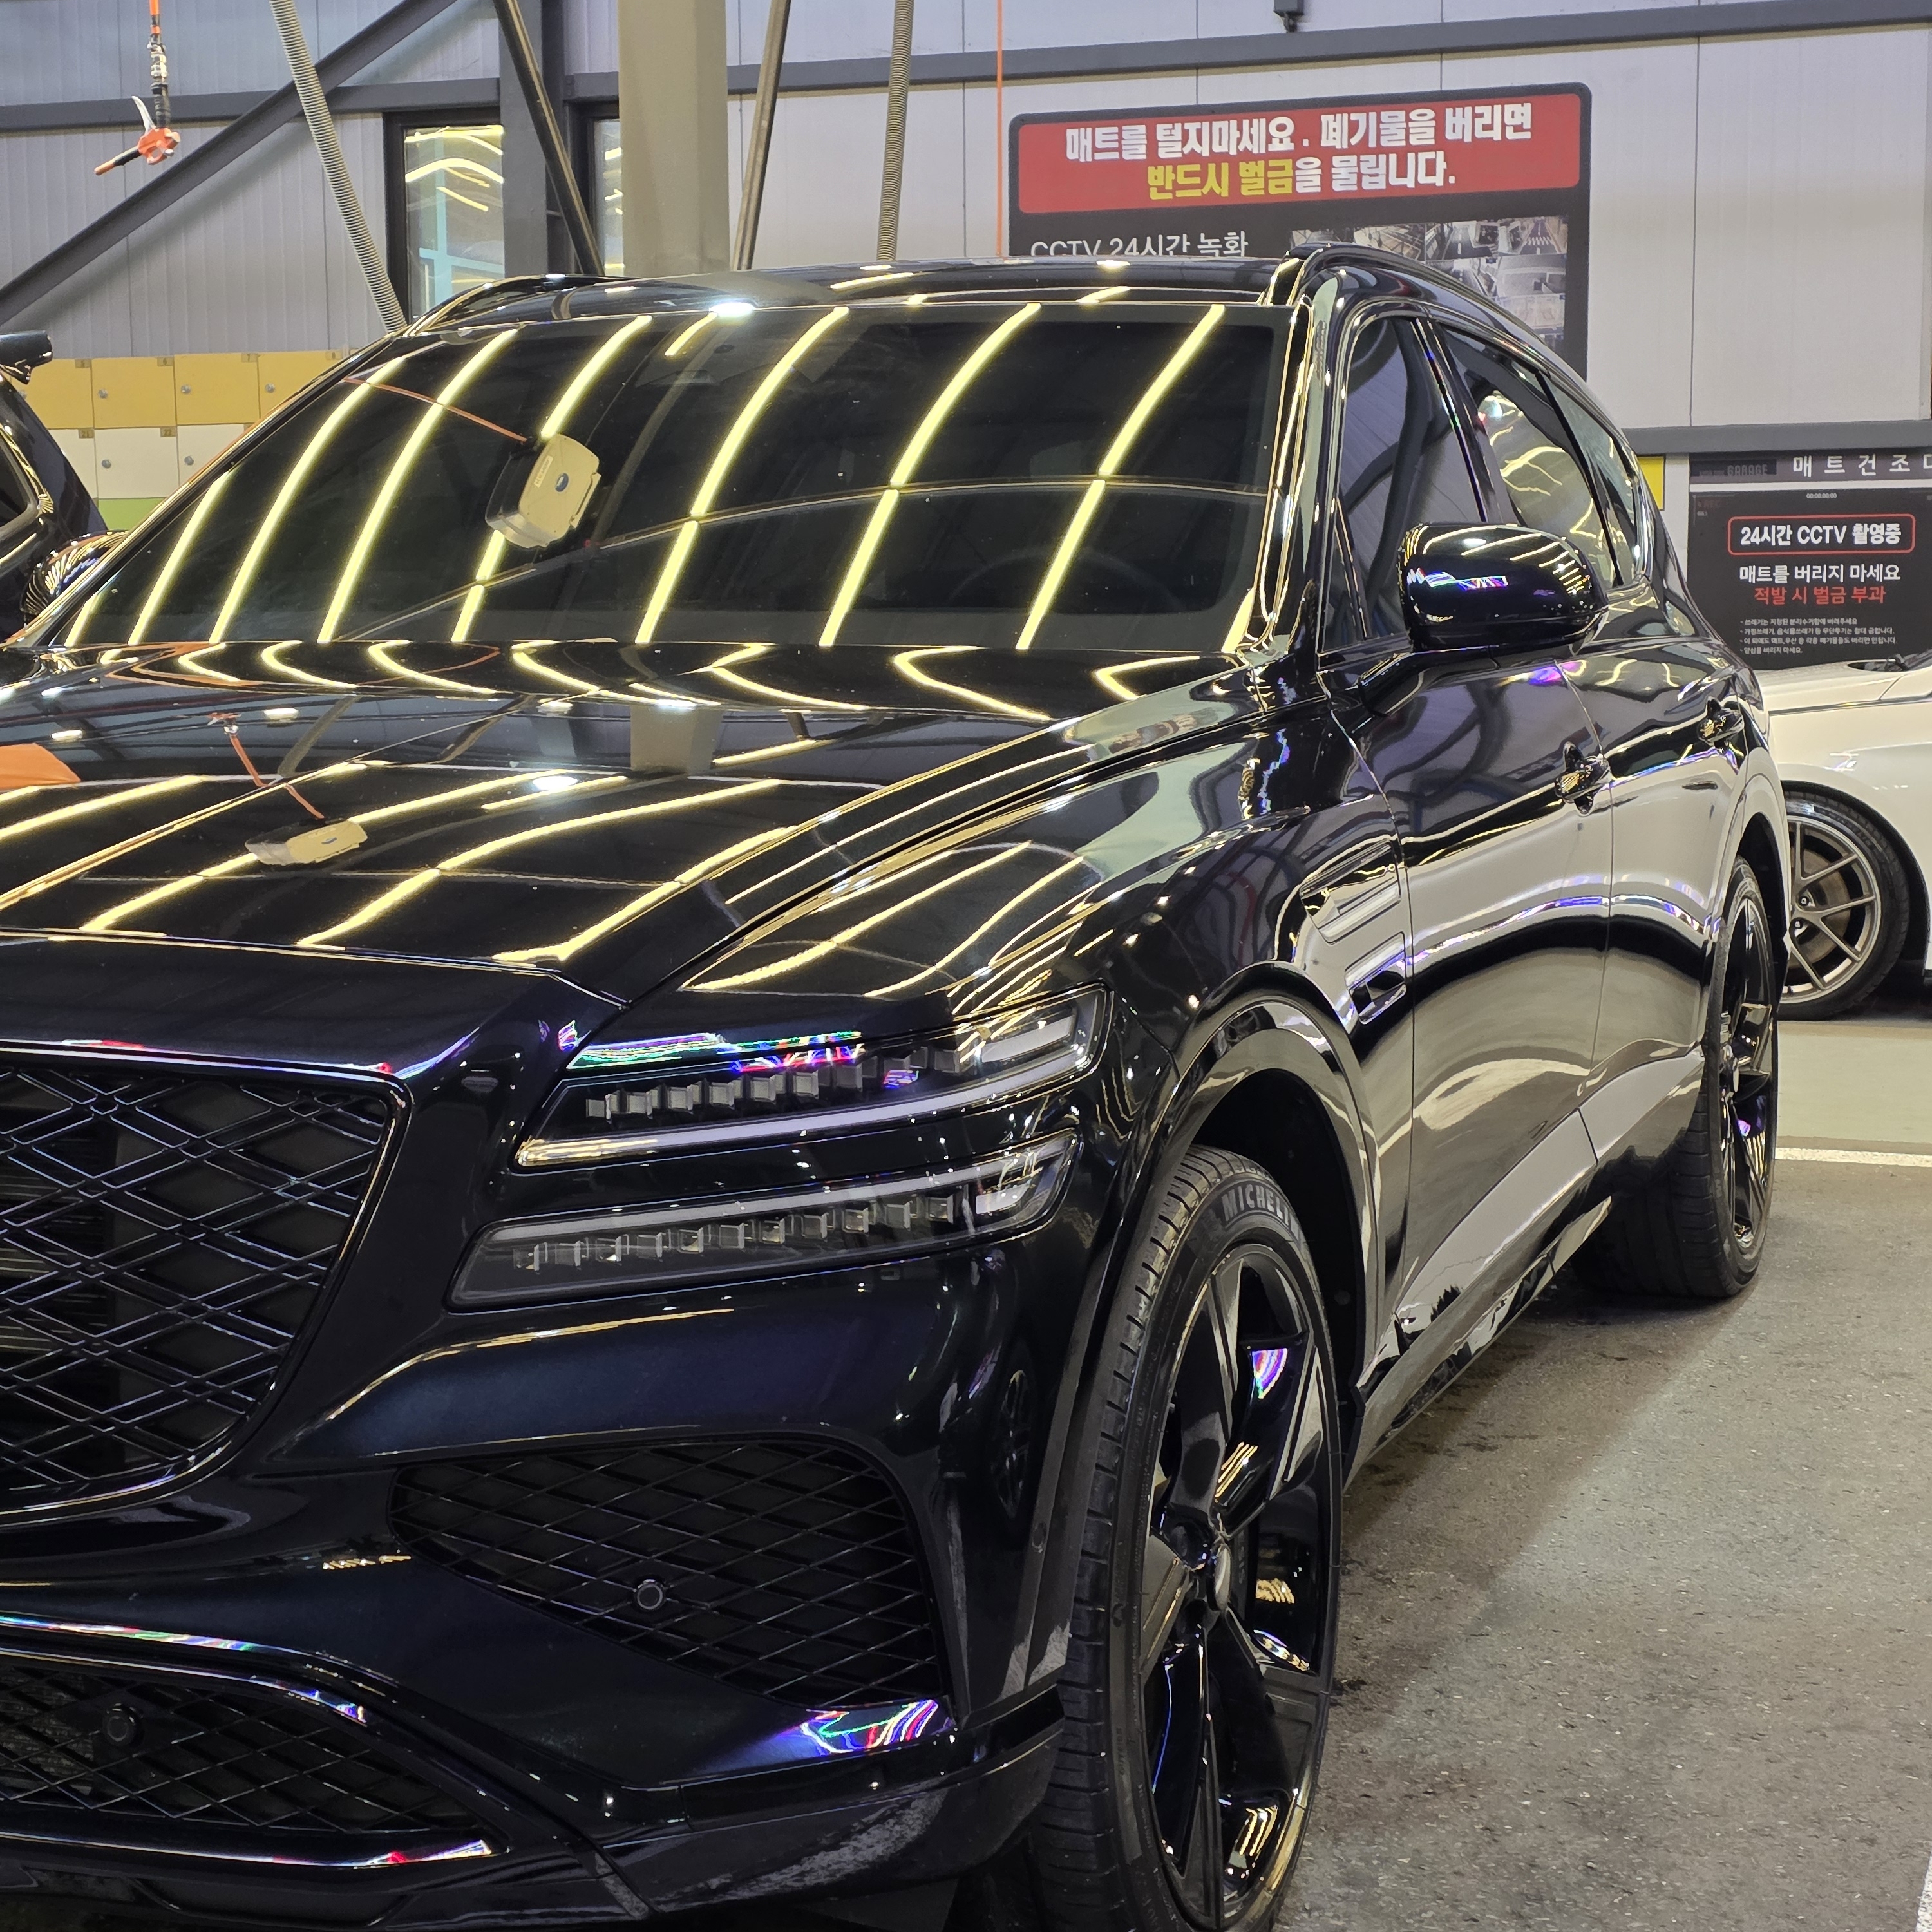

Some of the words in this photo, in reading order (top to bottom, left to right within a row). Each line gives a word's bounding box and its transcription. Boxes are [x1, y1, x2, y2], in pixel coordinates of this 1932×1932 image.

[1066, 124, 1147, 162] 매트를
[1320, 108, 1437, 149] 폐기물을
[1445, 102, 1531, 143] 버리면
[1148, 162, 1229, 200] 반드시
[1239, 156, 1321, 196] 벌금을
[1331, 151, 1455, 192] 물립니다.
[1030, 239, 1101, 256] CCTV
[1197, 231, 1248, 258] 녹화
[1741, 524, 1793, 546] 24시간
[1797, 525, 1847, 544] CCTV
[1852, 522, 1902, 545] 촬영중
[1739, 565, 1790, 584] 매트를
[1794, 564, 1844, 583] 버리지
[1850, 563, 1901, 583] 마세요
[1754, 587, 1787, 605] 적발
[1792, 586, 1807, 605] 시
[1814, 586, 1846, 605] 벌금
[1852, 585, 1886, 604] 부과
